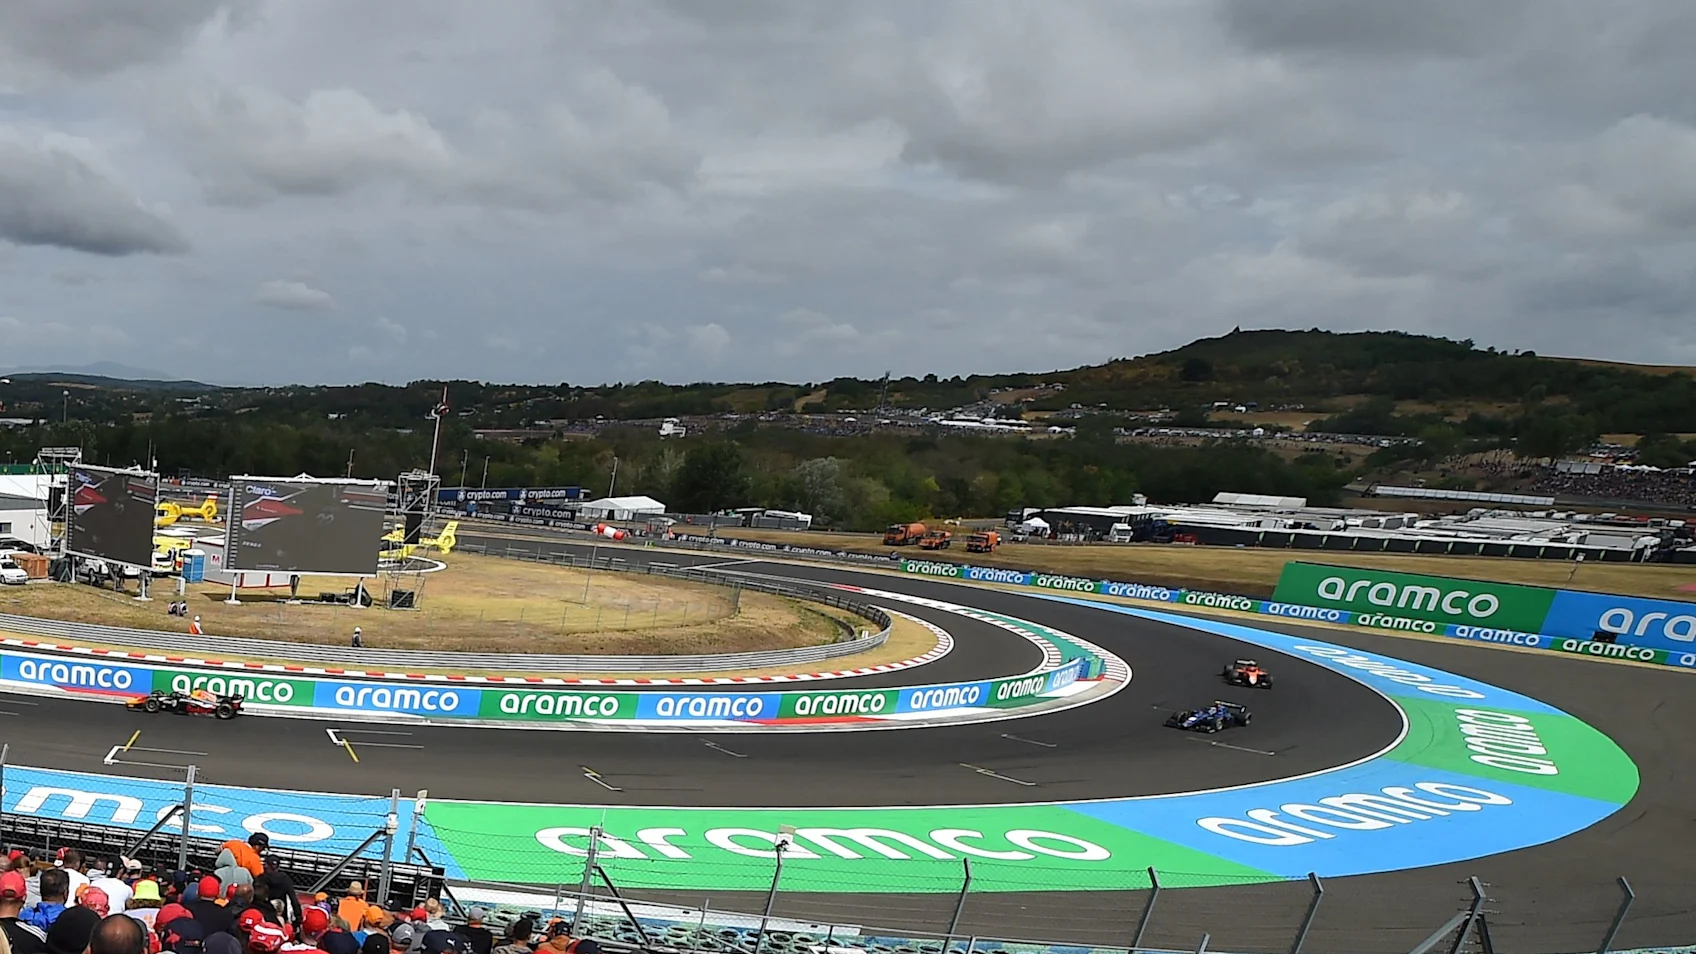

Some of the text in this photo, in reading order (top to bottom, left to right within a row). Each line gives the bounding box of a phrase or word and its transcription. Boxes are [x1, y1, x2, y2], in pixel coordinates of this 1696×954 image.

[246, 485, 272, 496] Claro
[467, 490, 507, 500] crypto.com
[528, 489, 566, 499] crypto.com
[522, 506, 572, 519] crypto.com
[688, 534, 724, 545] crypto.com
[738, 540, 776, 550] crypto.com
[906, 562, 958, 576] aramco
[970, 568, 1024, 584] aramco
[1037, 574, 1094, 592] aramco
[1108, 584, 1170, 600] aramco
[1186, 592, 1252, 610] aramco
[1317, 576, 1500, 618] aramco
[1268, 602, 1340, 621] aramco
[1358, 613, 1436, 634] aramco
[1455, 625, 1540, 647] aramco
[1562, 638, 1655, 661] aramco
[19, 658, 133, 690] aramco
[1294, 646, 1486, 699] aramco
[172, 673, 294, 703] aramco
[335, 685, 460, 713] aramco
[910, 686, 980, 709] aramco
[996, 676, 1044, 700] aramco
[499, 689, 619, 717] aramco
[656, 693, 764, 718] aramco
[794, 690, 886, 716] aramco
[1454, 708, 1559, 776] aramco
[1196, 782, 1514, 846] aramco
[534, 826, 1113, 862] aramco
